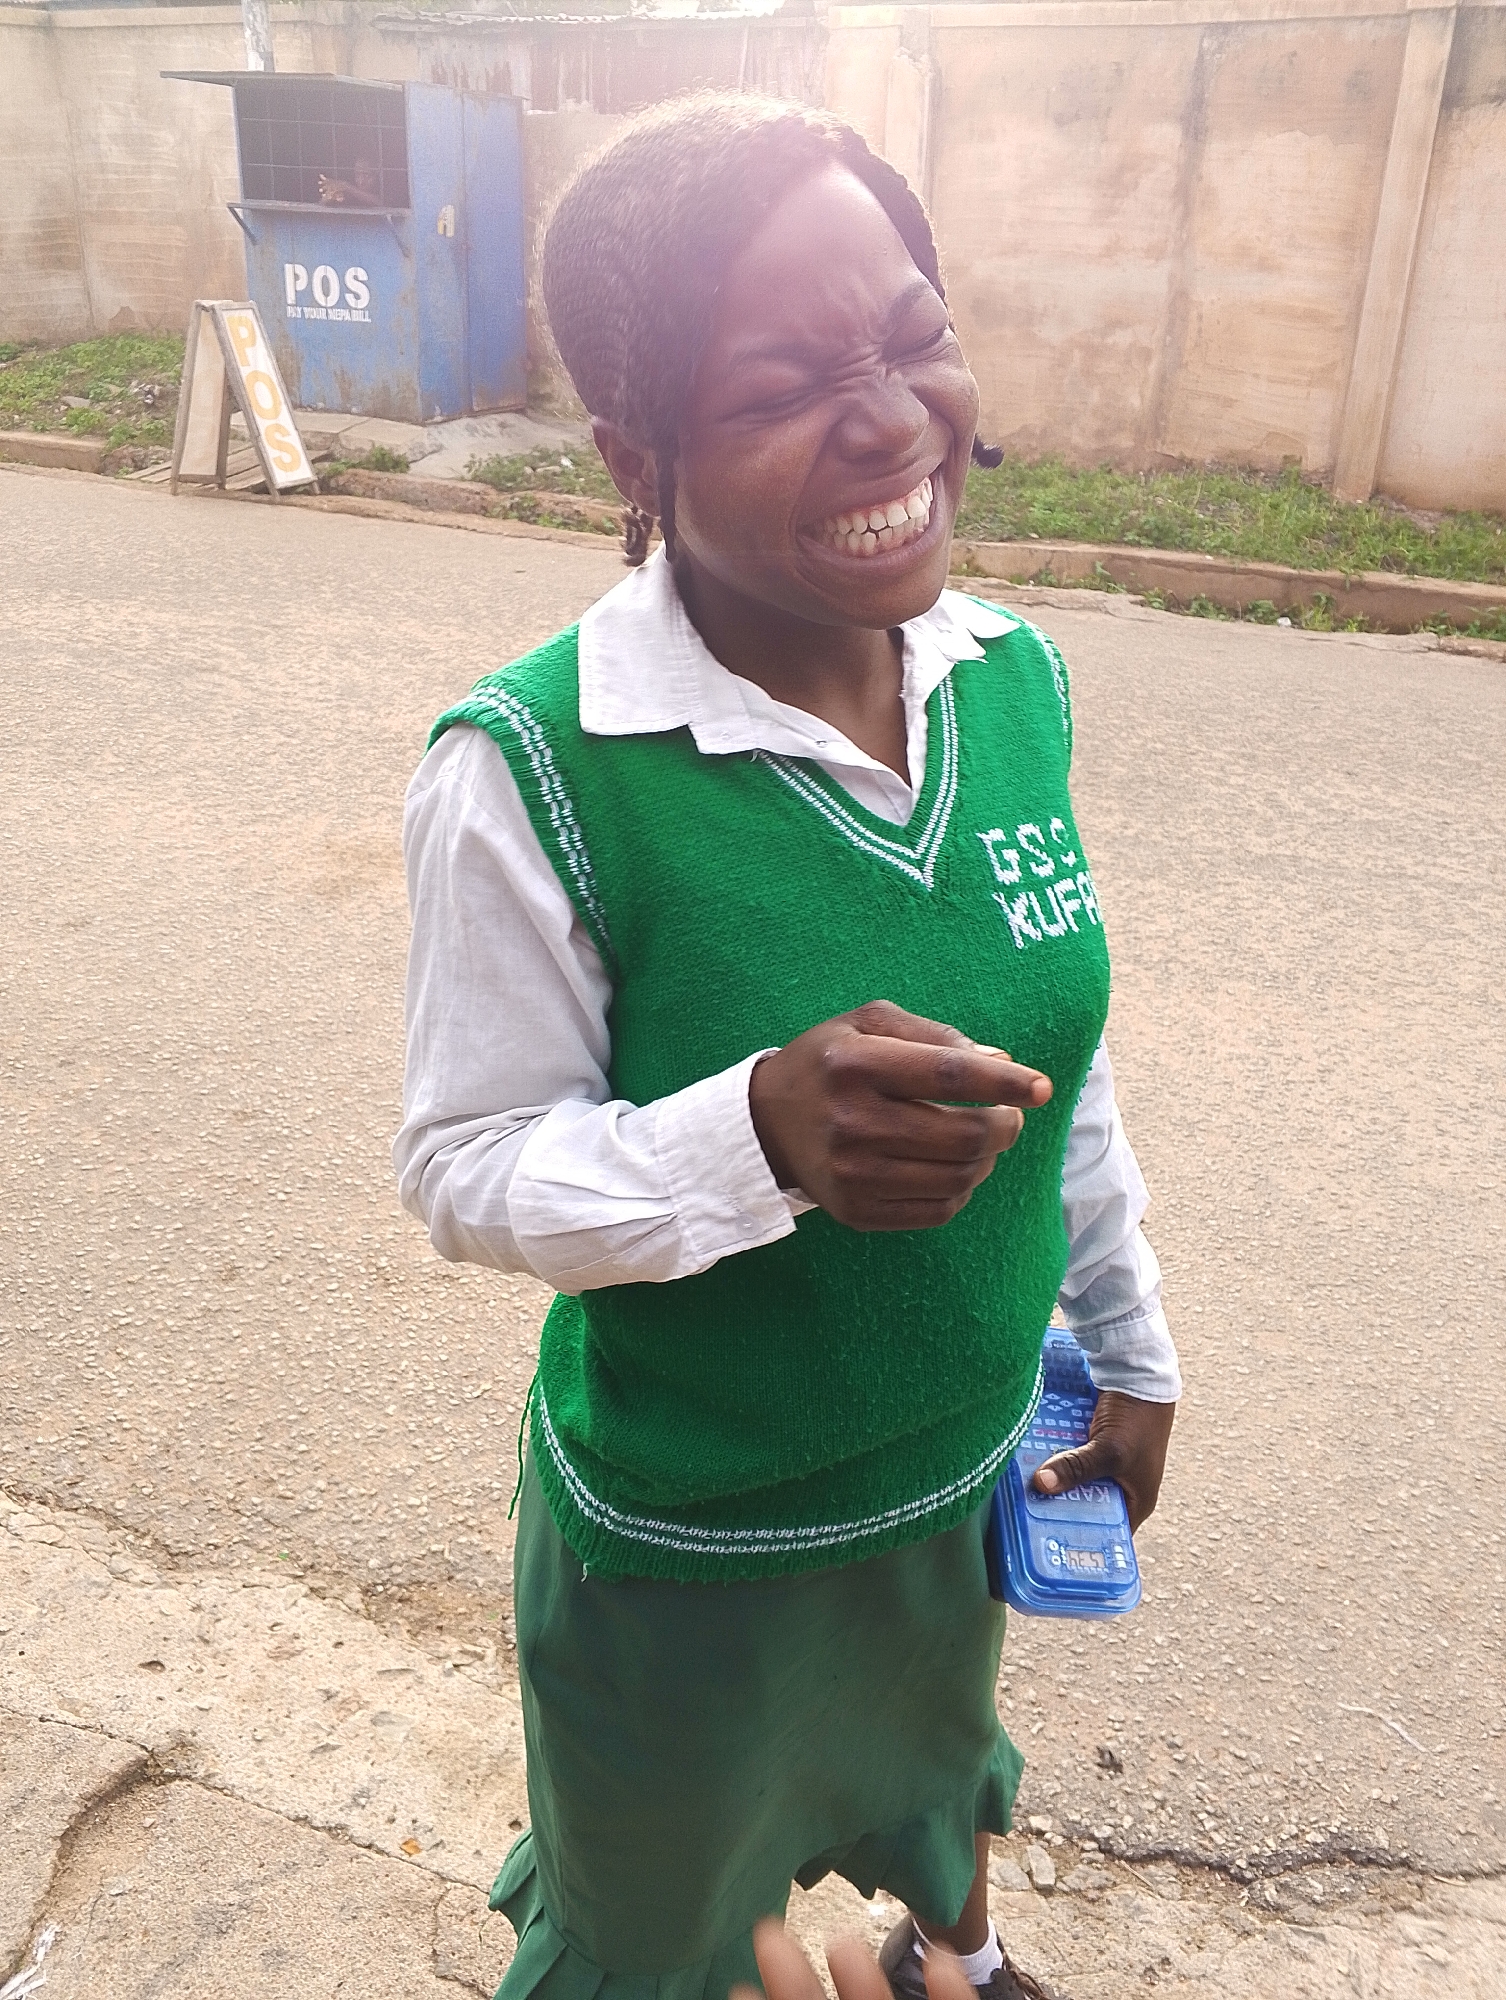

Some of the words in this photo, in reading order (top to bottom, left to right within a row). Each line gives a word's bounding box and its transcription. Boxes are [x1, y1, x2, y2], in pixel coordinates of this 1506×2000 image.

[284, 263, 370, 309] POS
[286, 306, 302, 319] PAY
[303, 307, 327, 320] YOUR
[327, 309, 351, 322] NEPA
[226, 316, 301, 472] POS
